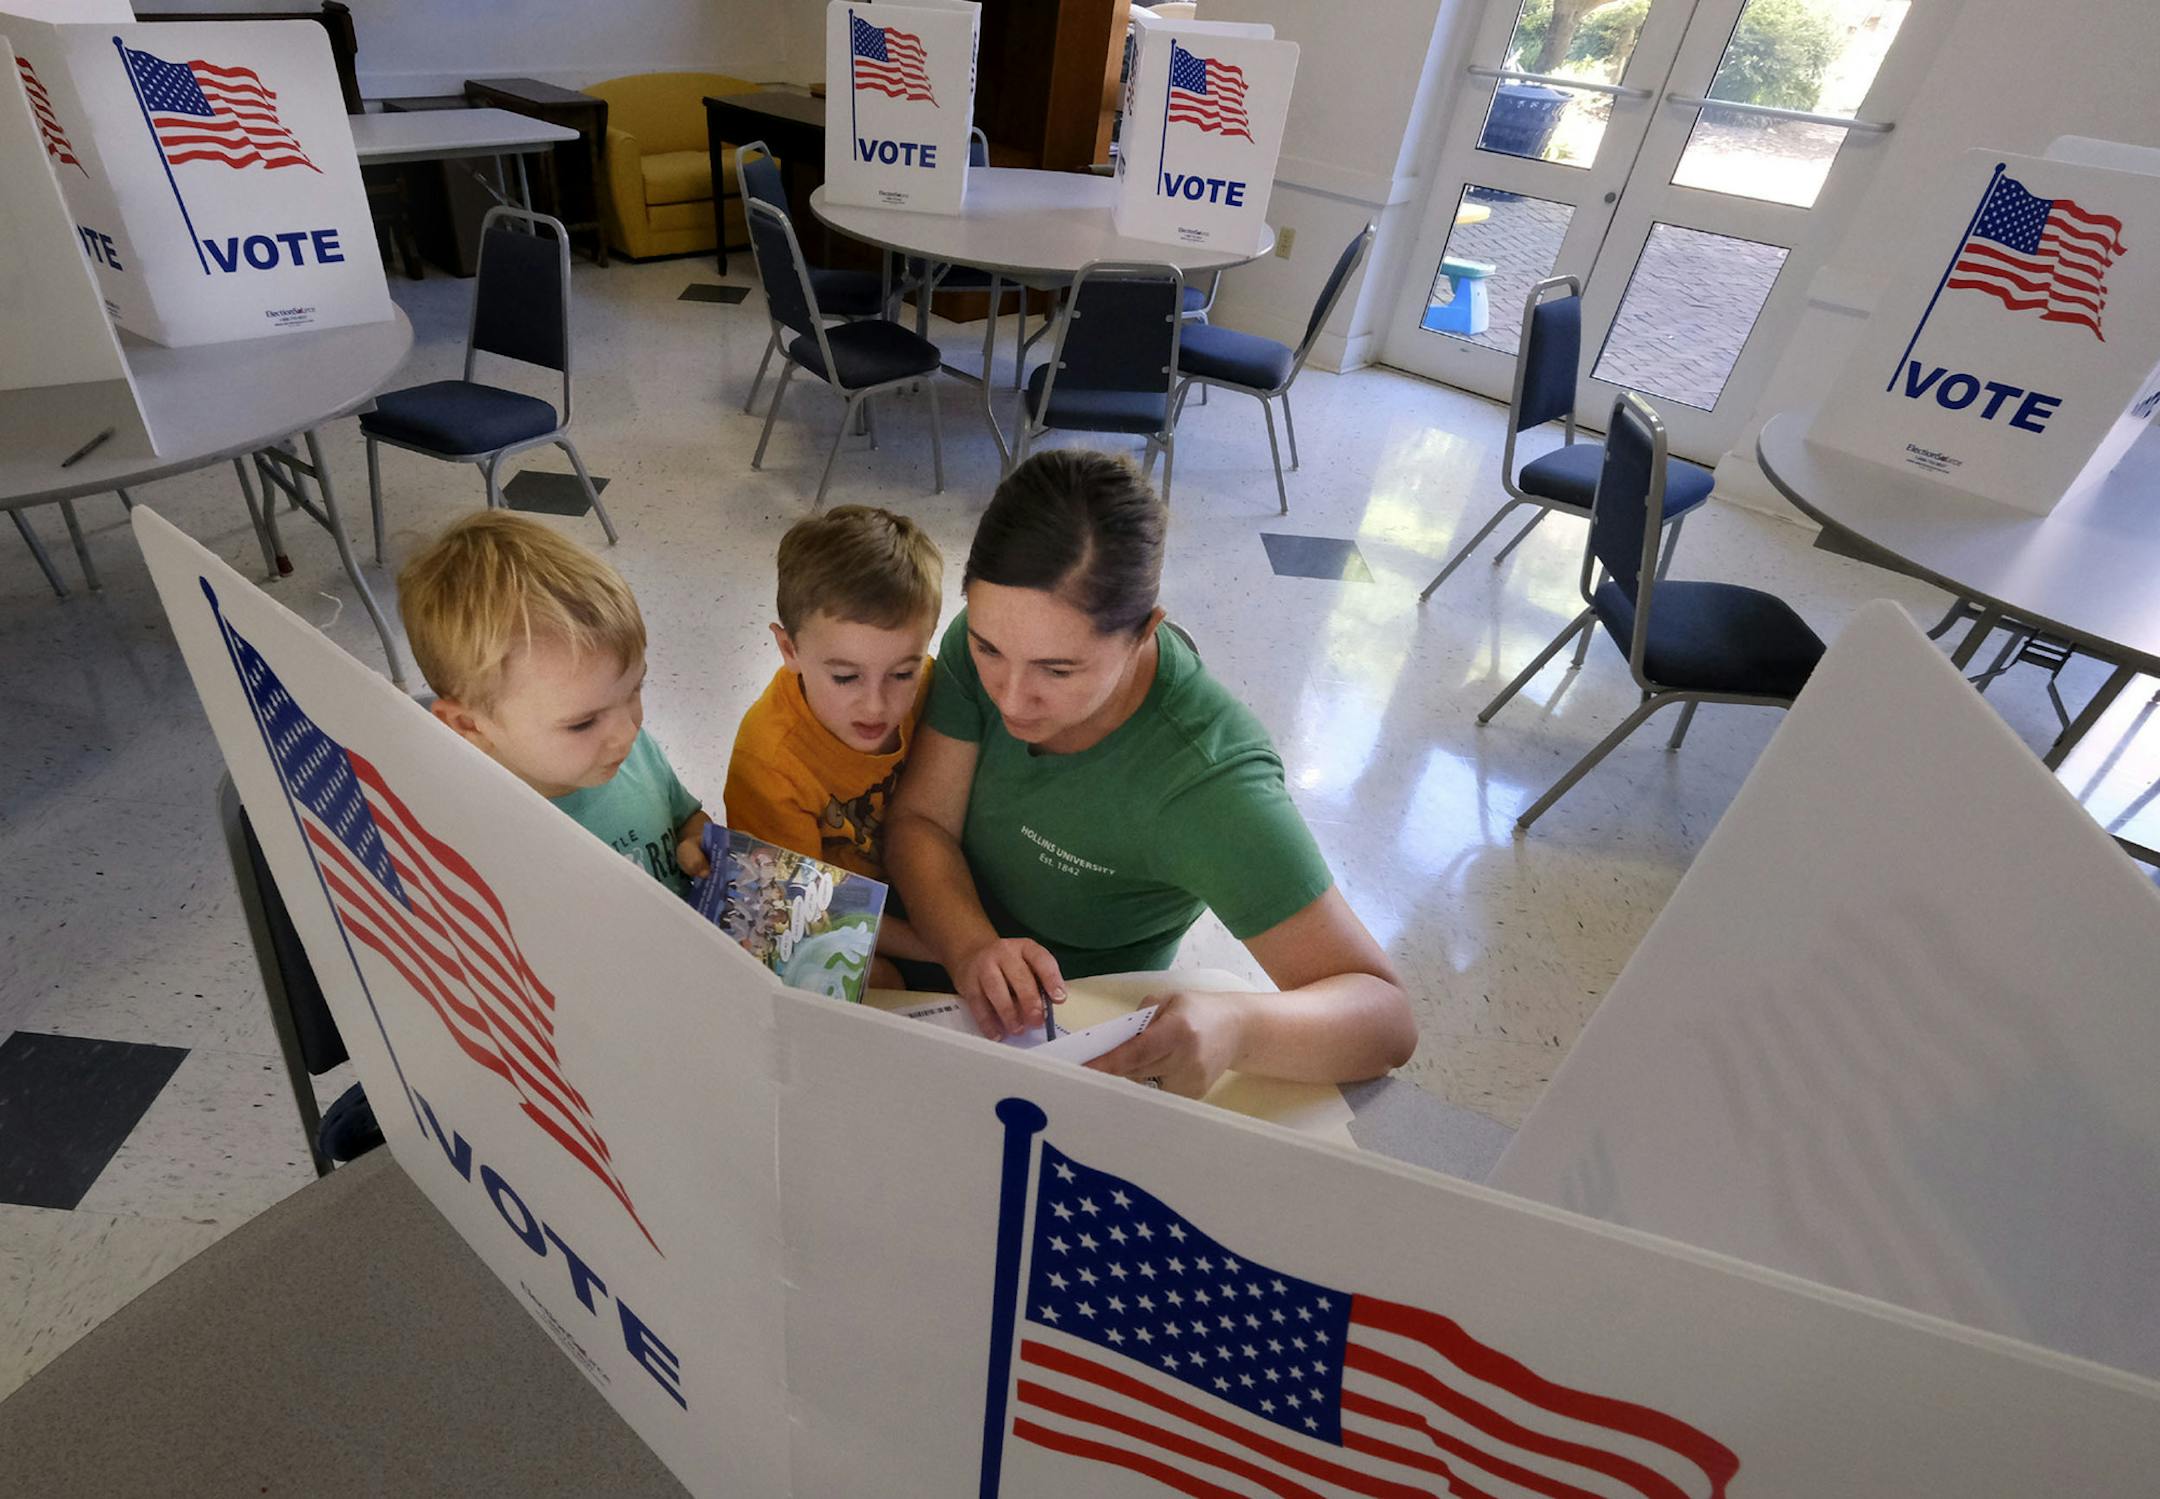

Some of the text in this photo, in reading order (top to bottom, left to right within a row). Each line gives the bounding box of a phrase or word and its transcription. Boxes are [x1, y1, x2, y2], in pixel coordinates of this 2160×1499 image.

[858, 138, 937, 168] VOTE
[1163, 172, 1246, 207] VOTE
[202, 229, 345, 273] VOTE
[1904, 360, 2063, 434] VOTE
[1020, 825, 1117, 875] HOLLINS UNIVERSITY
[1057, 861, 1081, 877] 1842
[411, 1087, 687, 1411] VOTE
